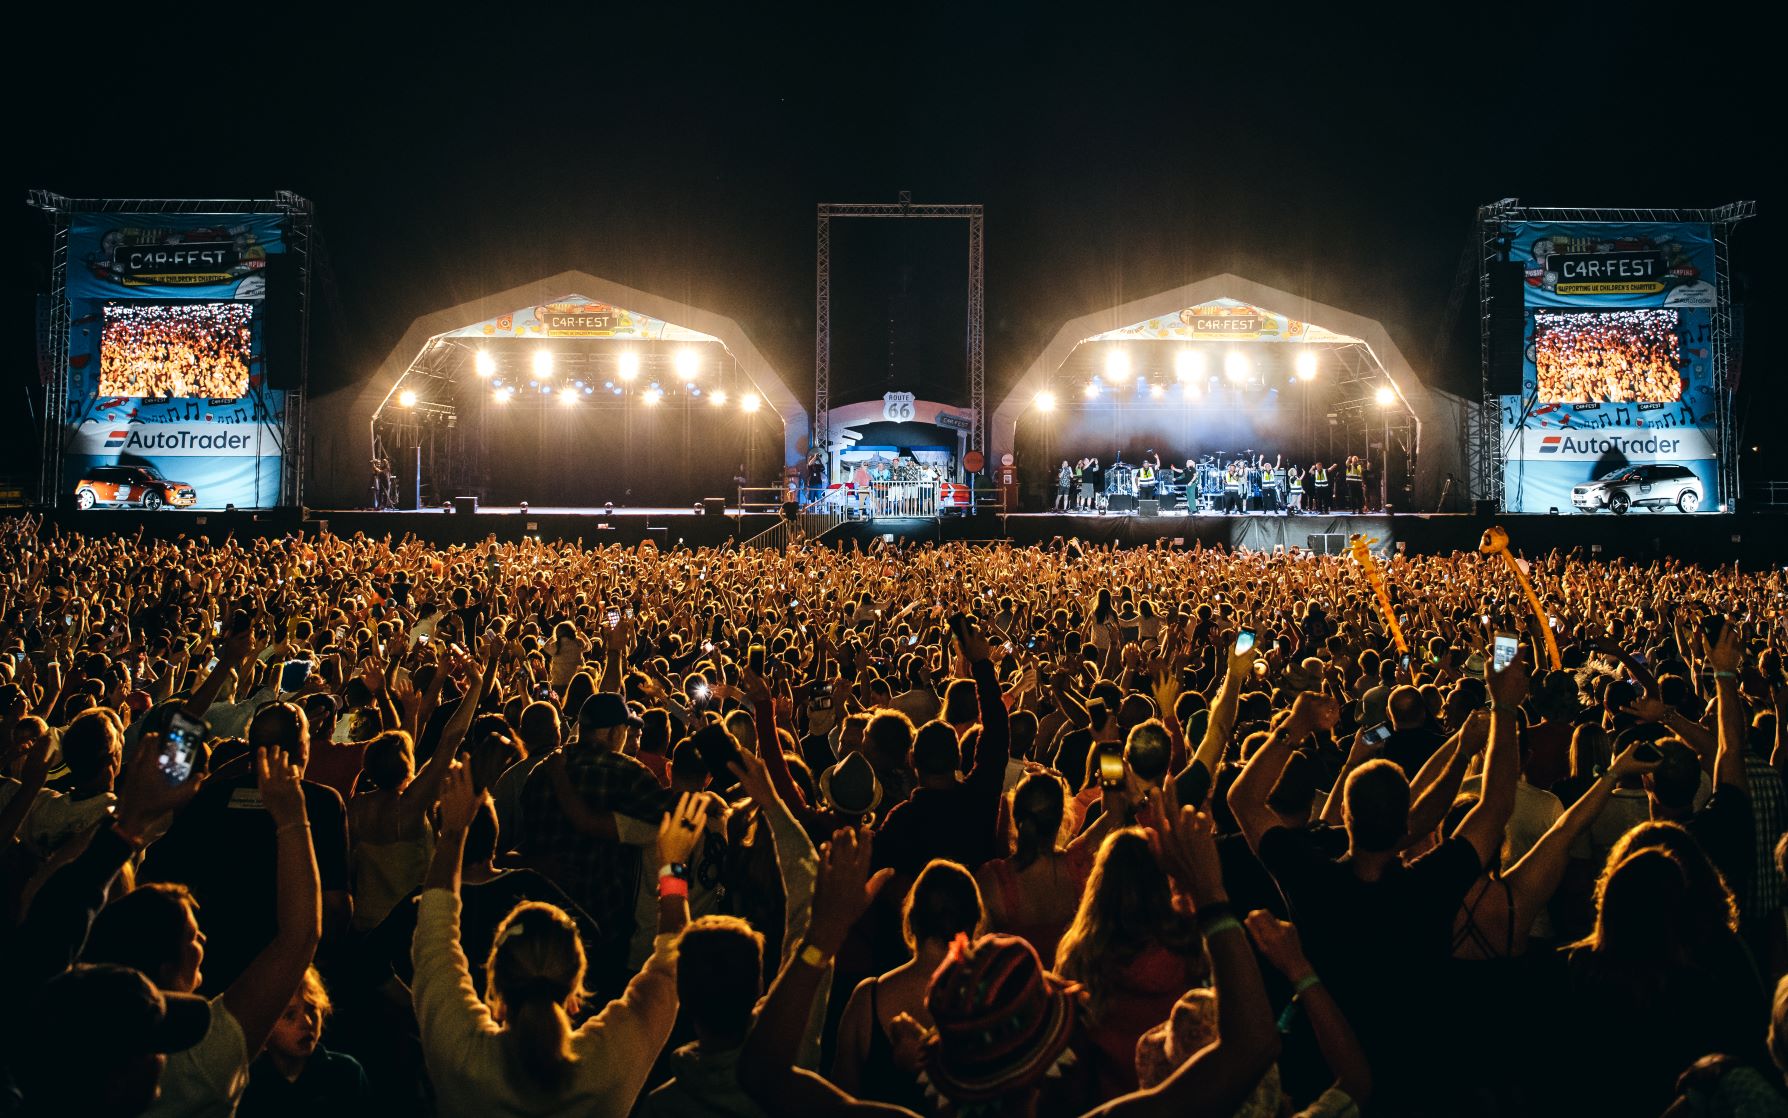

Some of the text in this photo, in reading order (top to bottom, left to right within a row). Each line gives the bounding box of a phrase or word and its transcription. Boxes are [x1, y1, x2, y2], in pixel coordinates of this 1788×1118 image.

[888, 403, 910, 418] 66
[127, 430, 251, 450] AutoTrader
[1561, 435, 1680, 454] AutoTrader
